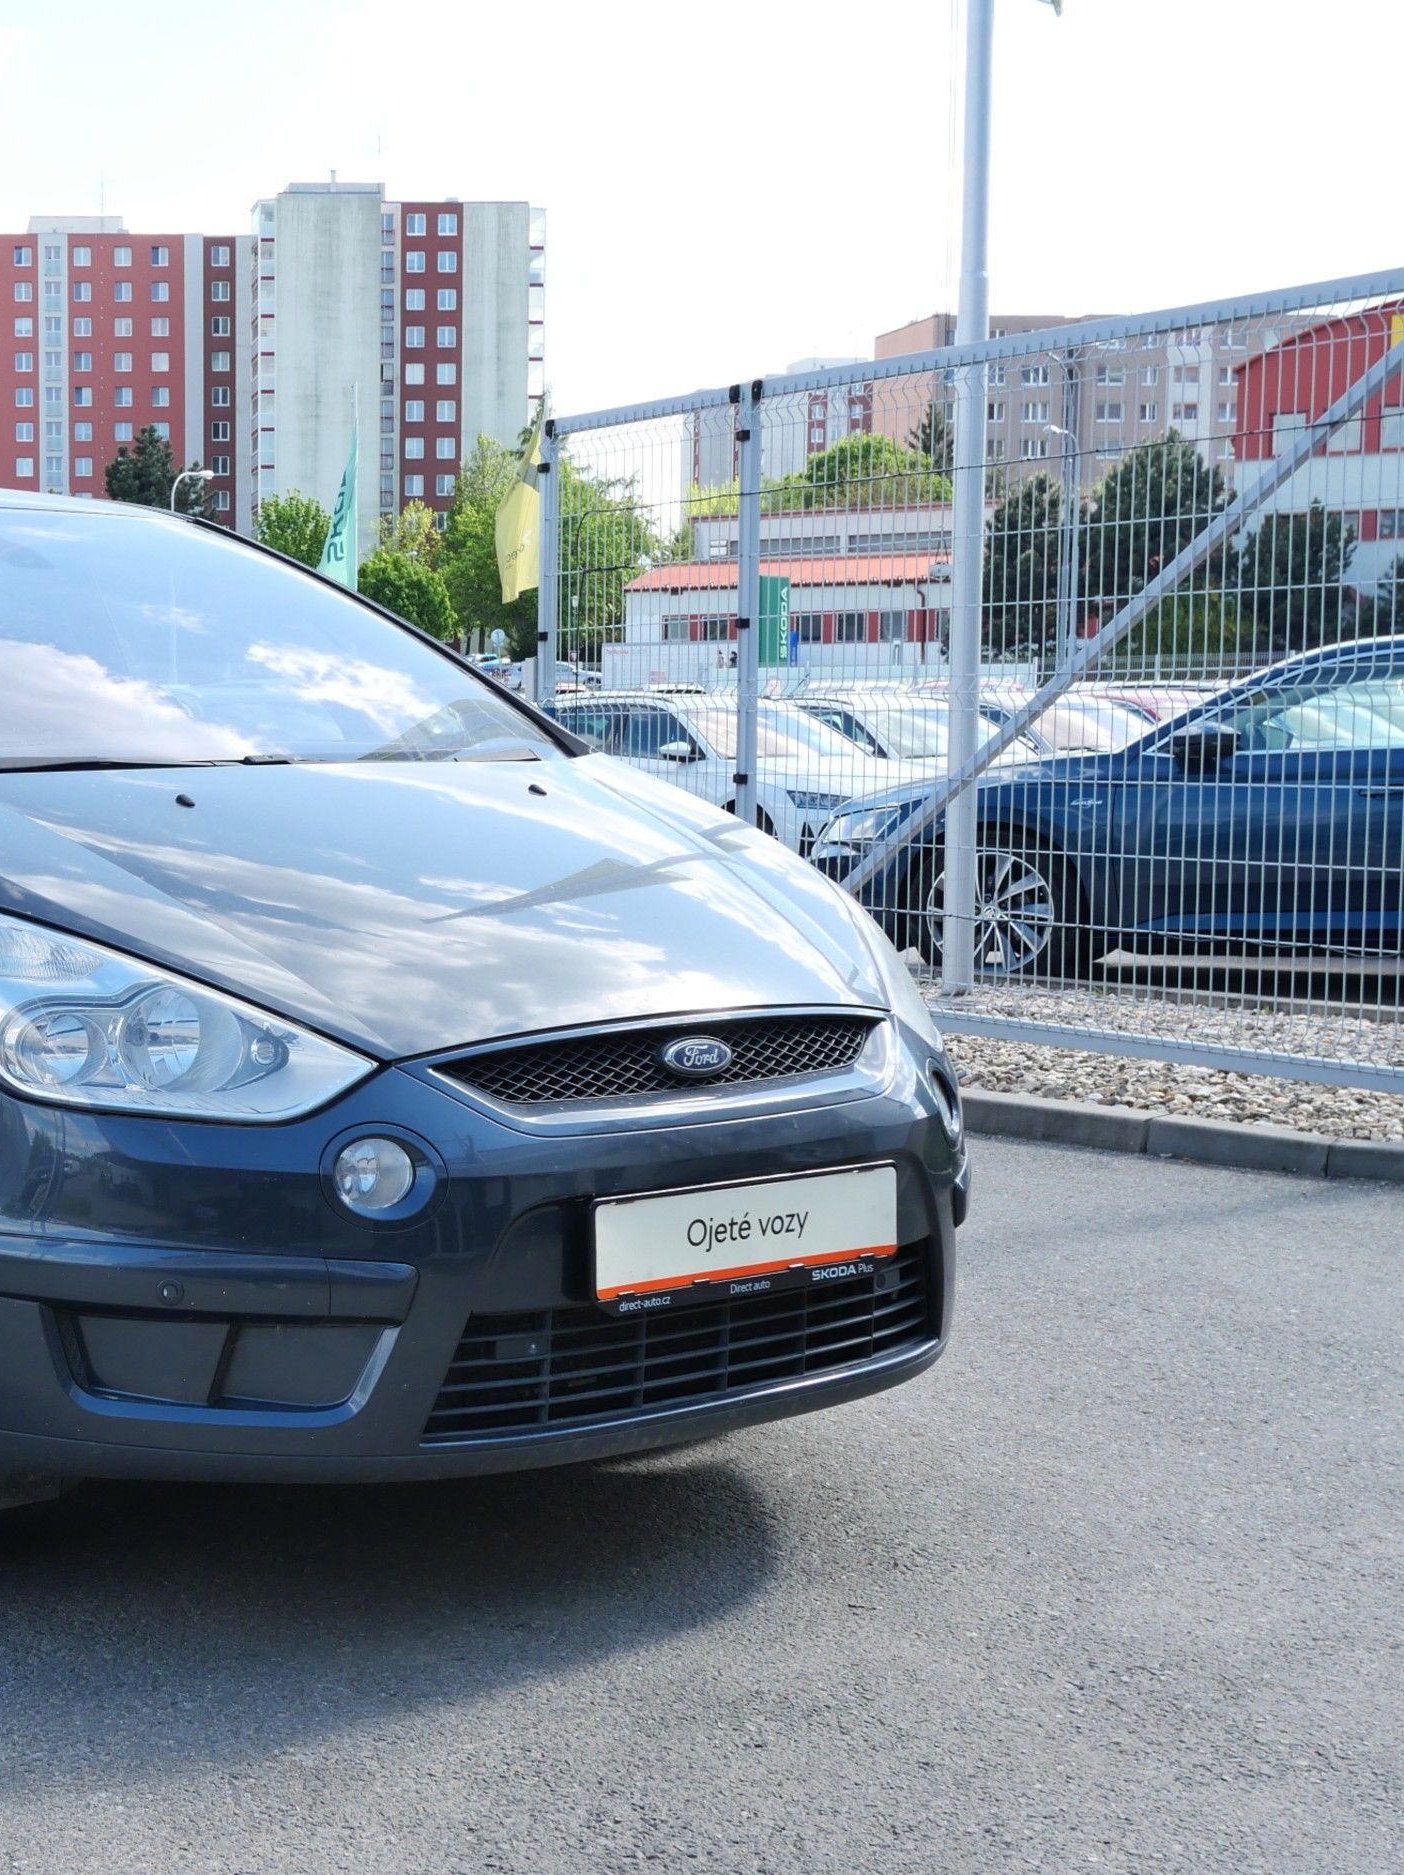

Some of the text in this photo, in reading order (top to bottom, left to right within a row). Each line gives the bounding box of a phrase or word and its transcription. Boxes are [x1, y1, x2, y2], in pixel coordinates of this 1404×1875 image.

[683, 1045, 719, 1067] Ford
[687, 1210, 808, 1252] Ojeté vozy
[858, 1263, 874, 1273] Plus
[730, 1279, 770, 1295] Direct auto
[619, 1296, 671, 1312] direct-auto.cz
